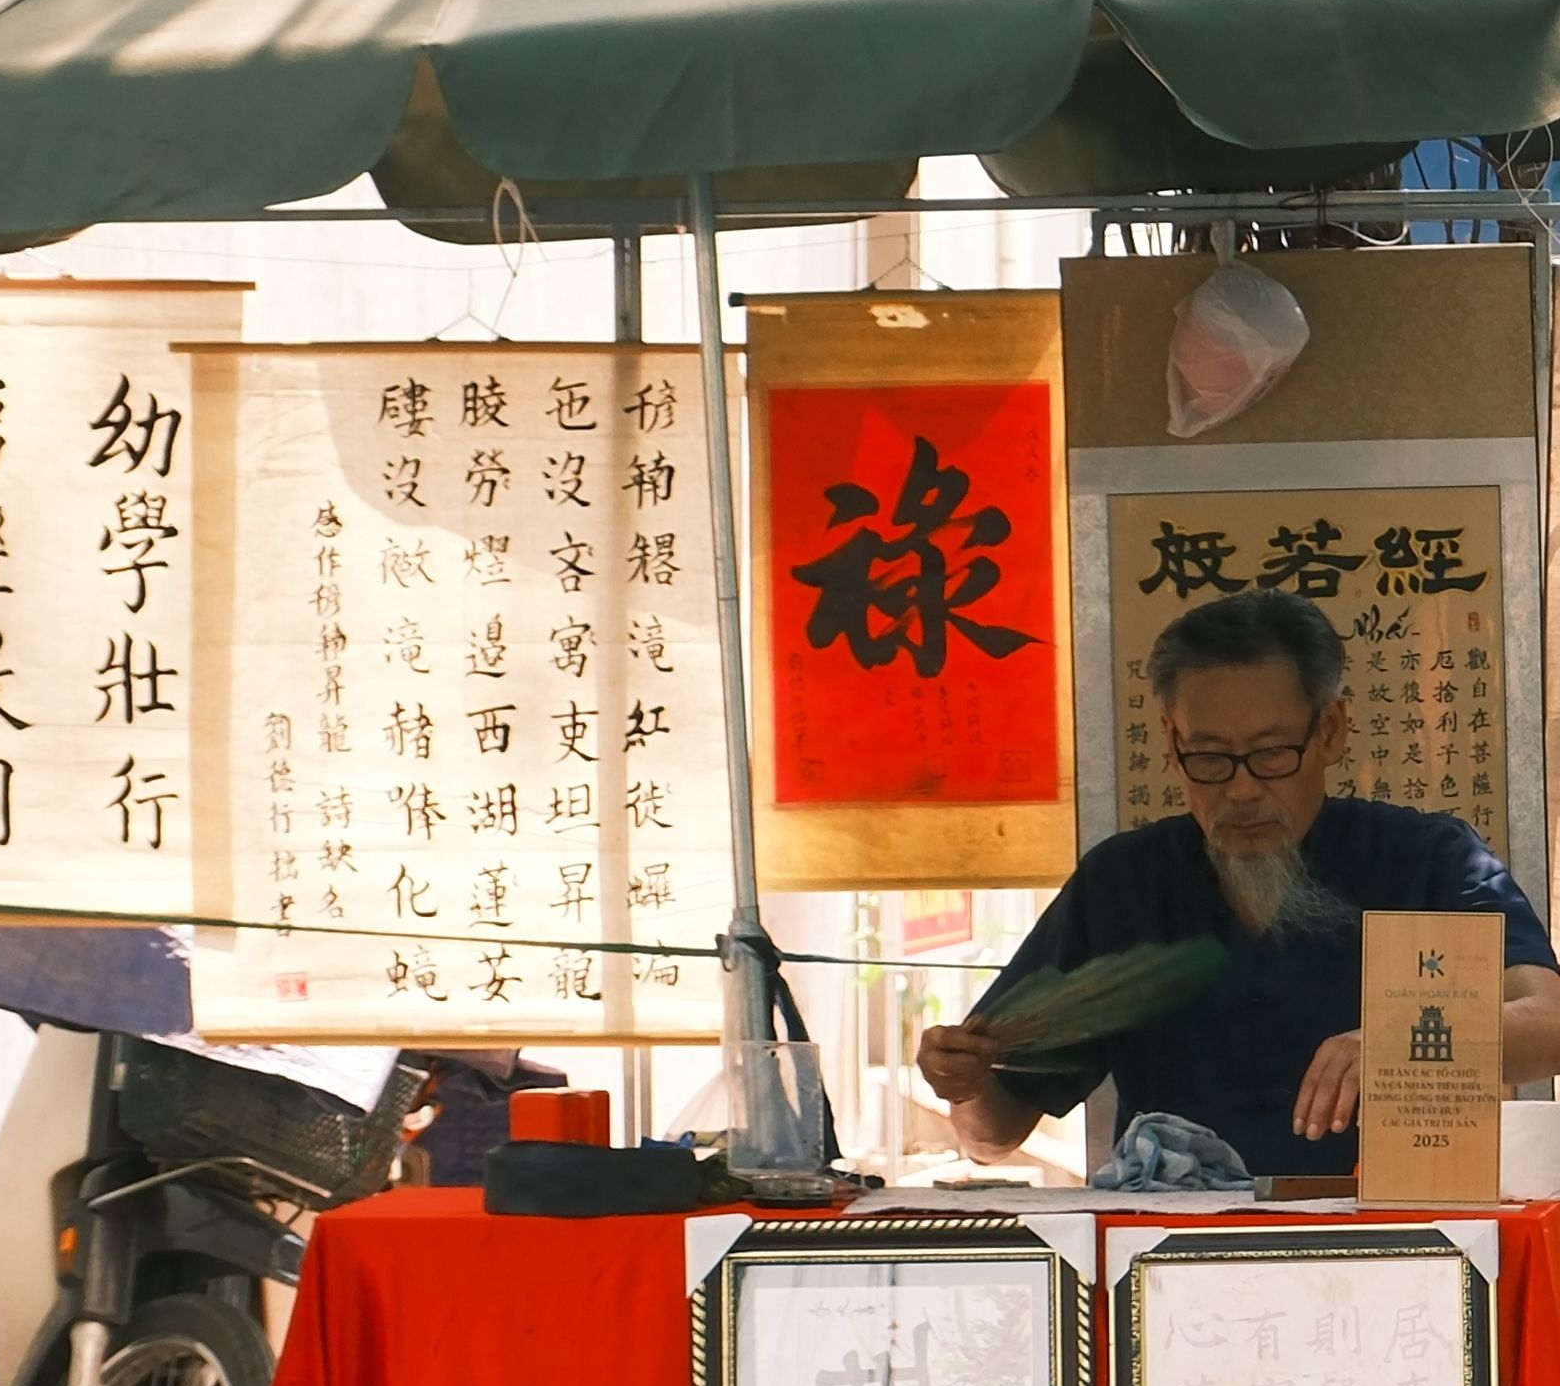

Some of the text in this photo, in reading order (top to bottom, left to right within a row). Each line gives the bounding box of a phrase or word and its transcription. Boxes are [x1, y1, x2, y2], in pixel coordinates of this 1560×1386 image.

[87, 373, 182, 850] 幼學壯行
[1139, 519, 1493, 599] 般若經
[1430, 650, 1460, 816] 厄捨利子色
[1465, 648, 1495, 853] 觀自在菩薩行
[1412, 1134, 1450, 1148] 2025
